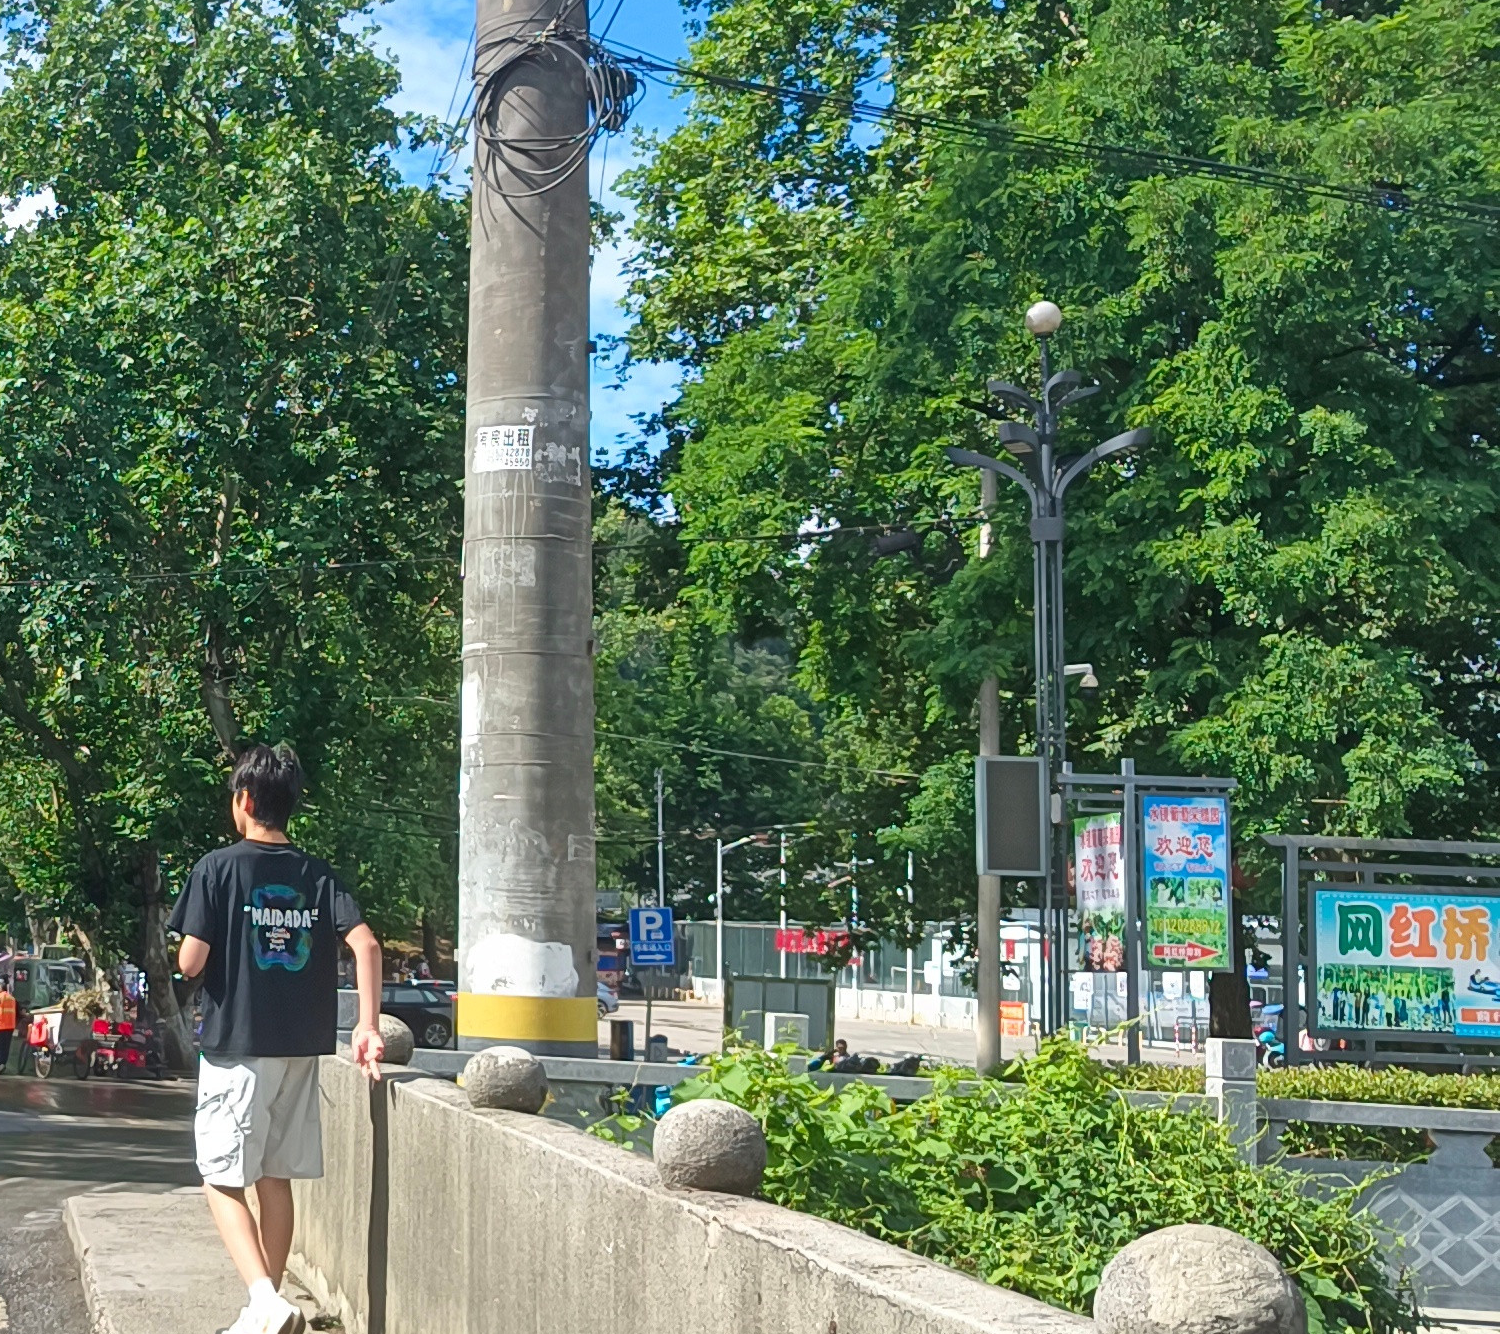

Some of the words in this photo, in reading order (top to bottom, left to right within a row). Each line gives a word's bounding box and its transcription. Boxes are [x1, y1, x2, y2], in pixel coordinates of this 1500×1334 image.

[1154, 835, 1214, 858] 欢迎您
[638, 910, 663, 941] P
[1338, 904, 1490, 962] 网红桥
